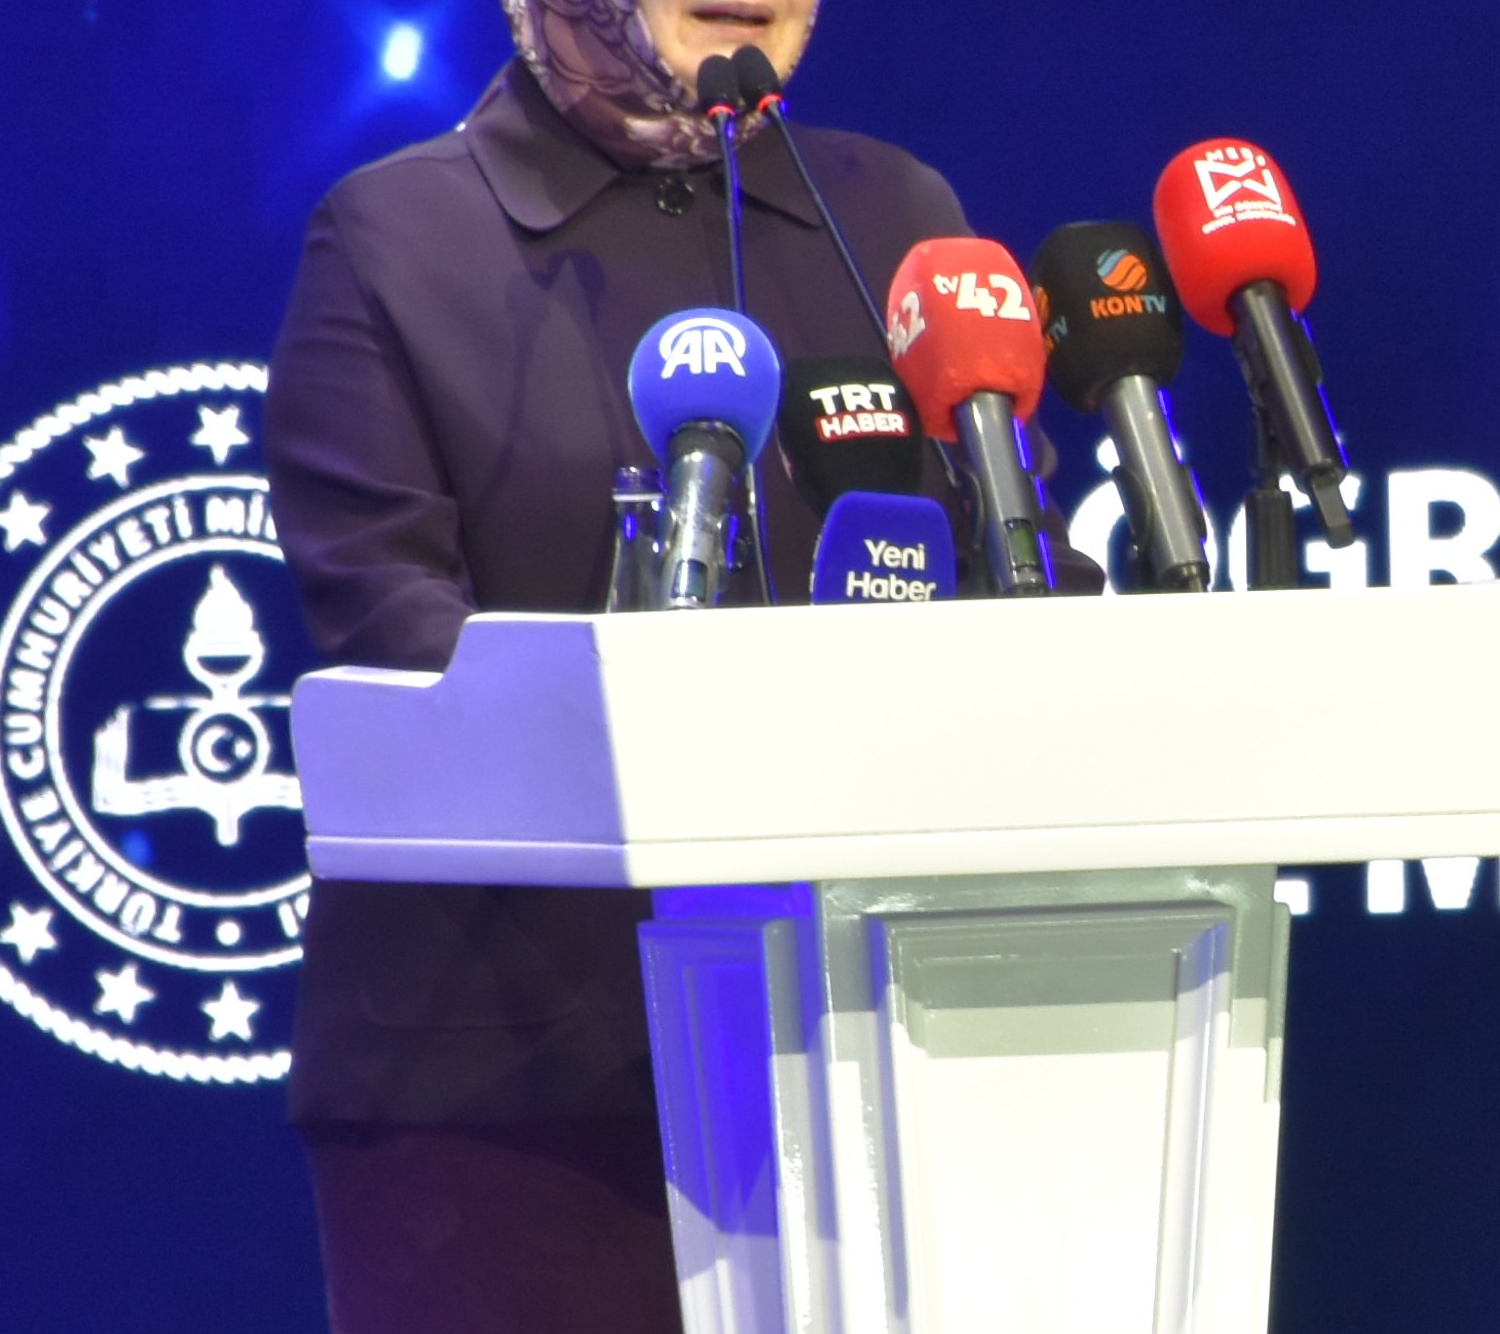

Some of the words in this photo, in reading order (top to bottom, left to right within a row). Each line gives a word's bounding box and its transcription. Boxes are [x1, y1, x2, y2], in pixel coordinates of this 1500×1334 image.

[1090, 294, 1167, 320] KONTV
[658, 321, 748, 380] AA
[809, 383, 896, 416] TRT
[820, 412, 906, 439] HABER
[864, 538, 926, 571] Yeni
[846, 570, 937, 602] Haber
